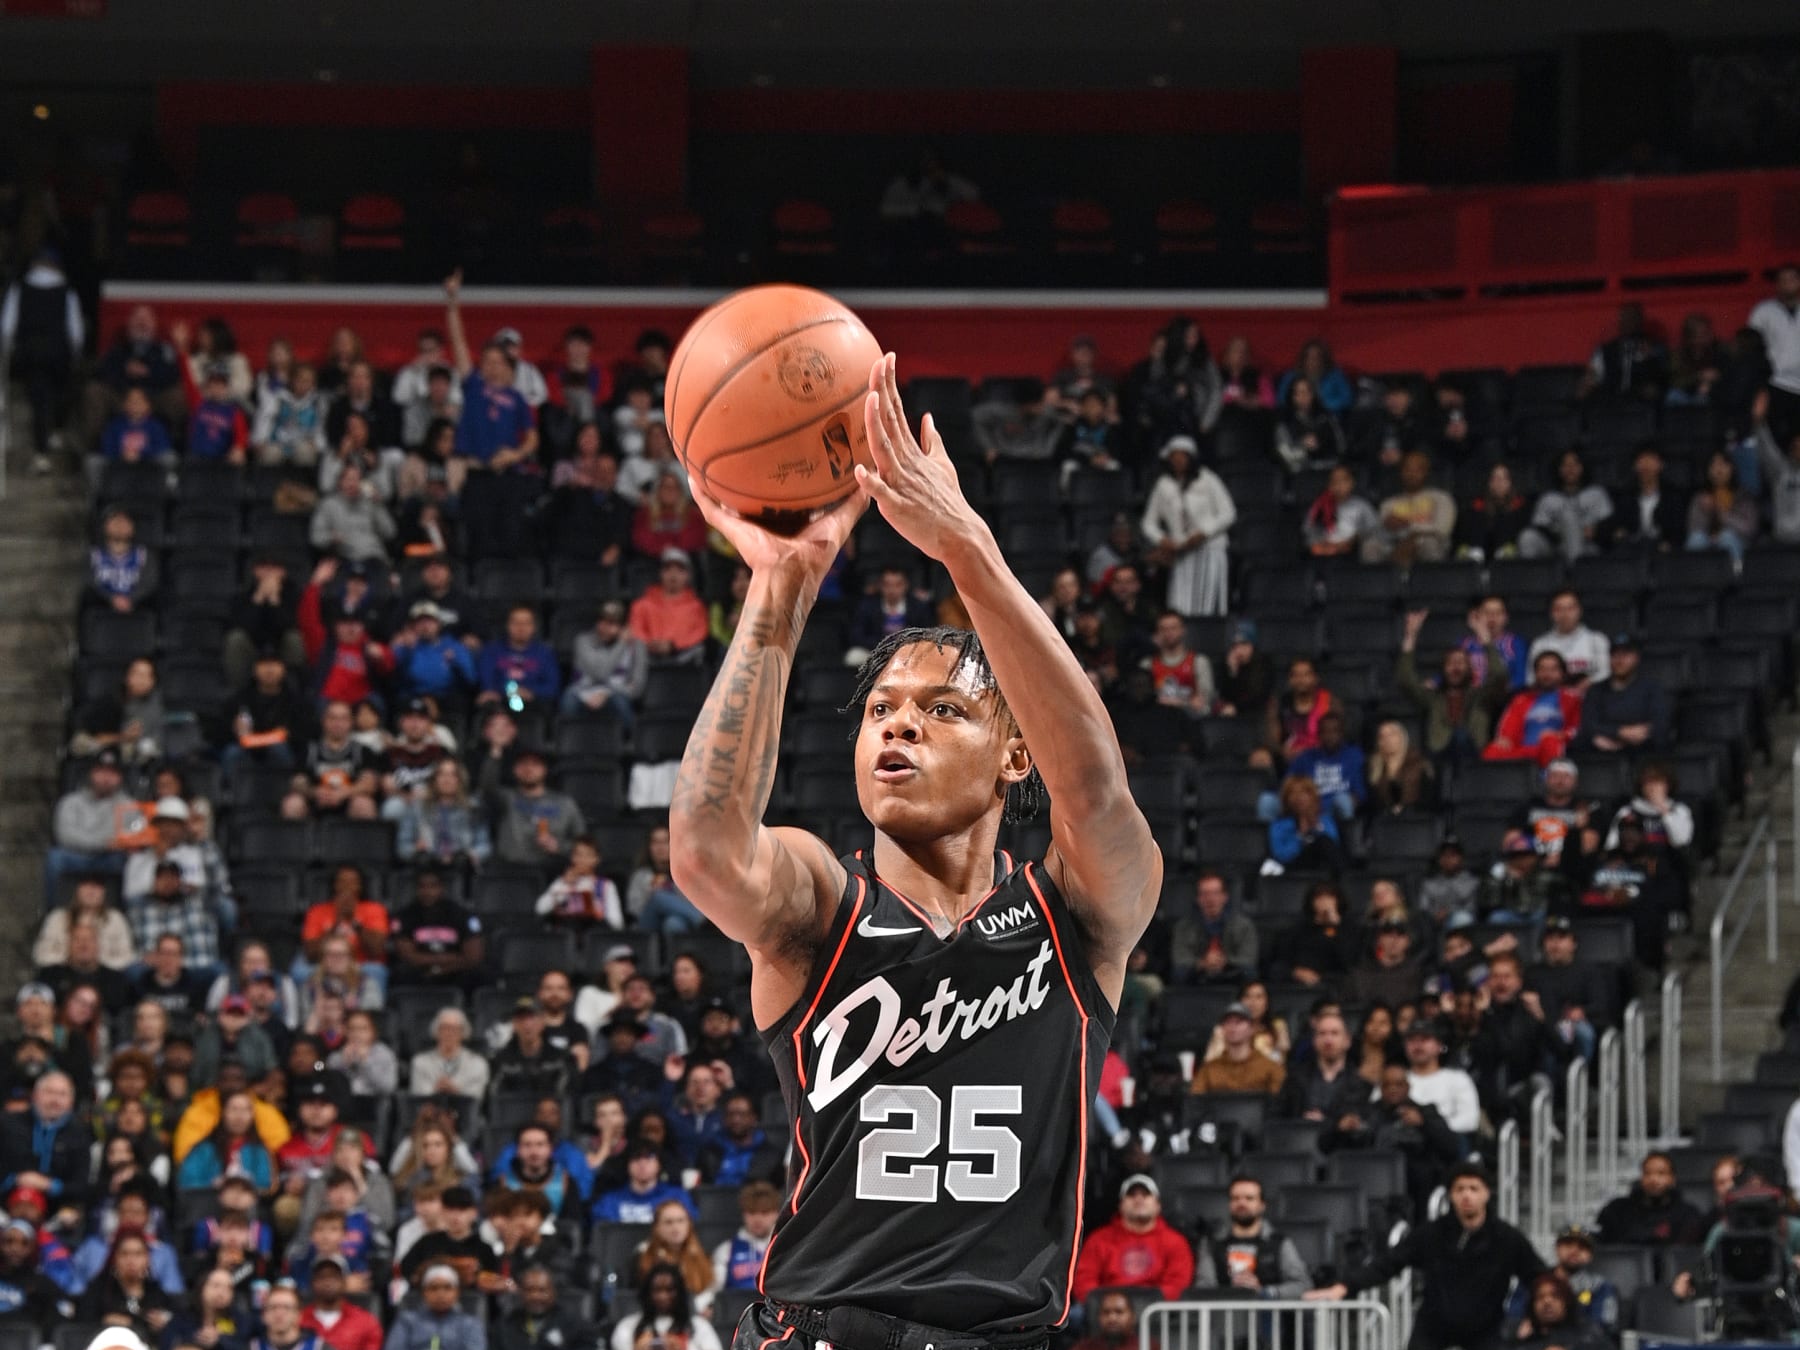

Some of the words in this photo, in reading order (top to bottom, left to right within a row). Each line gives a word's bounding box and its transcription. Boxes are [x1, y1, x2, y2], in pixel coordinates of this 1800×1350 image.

[976, 900, 1037, 935] UWM
[807, 938, 1053, 1113] Detroit
[855, 1083, 1023, 1203] 25
